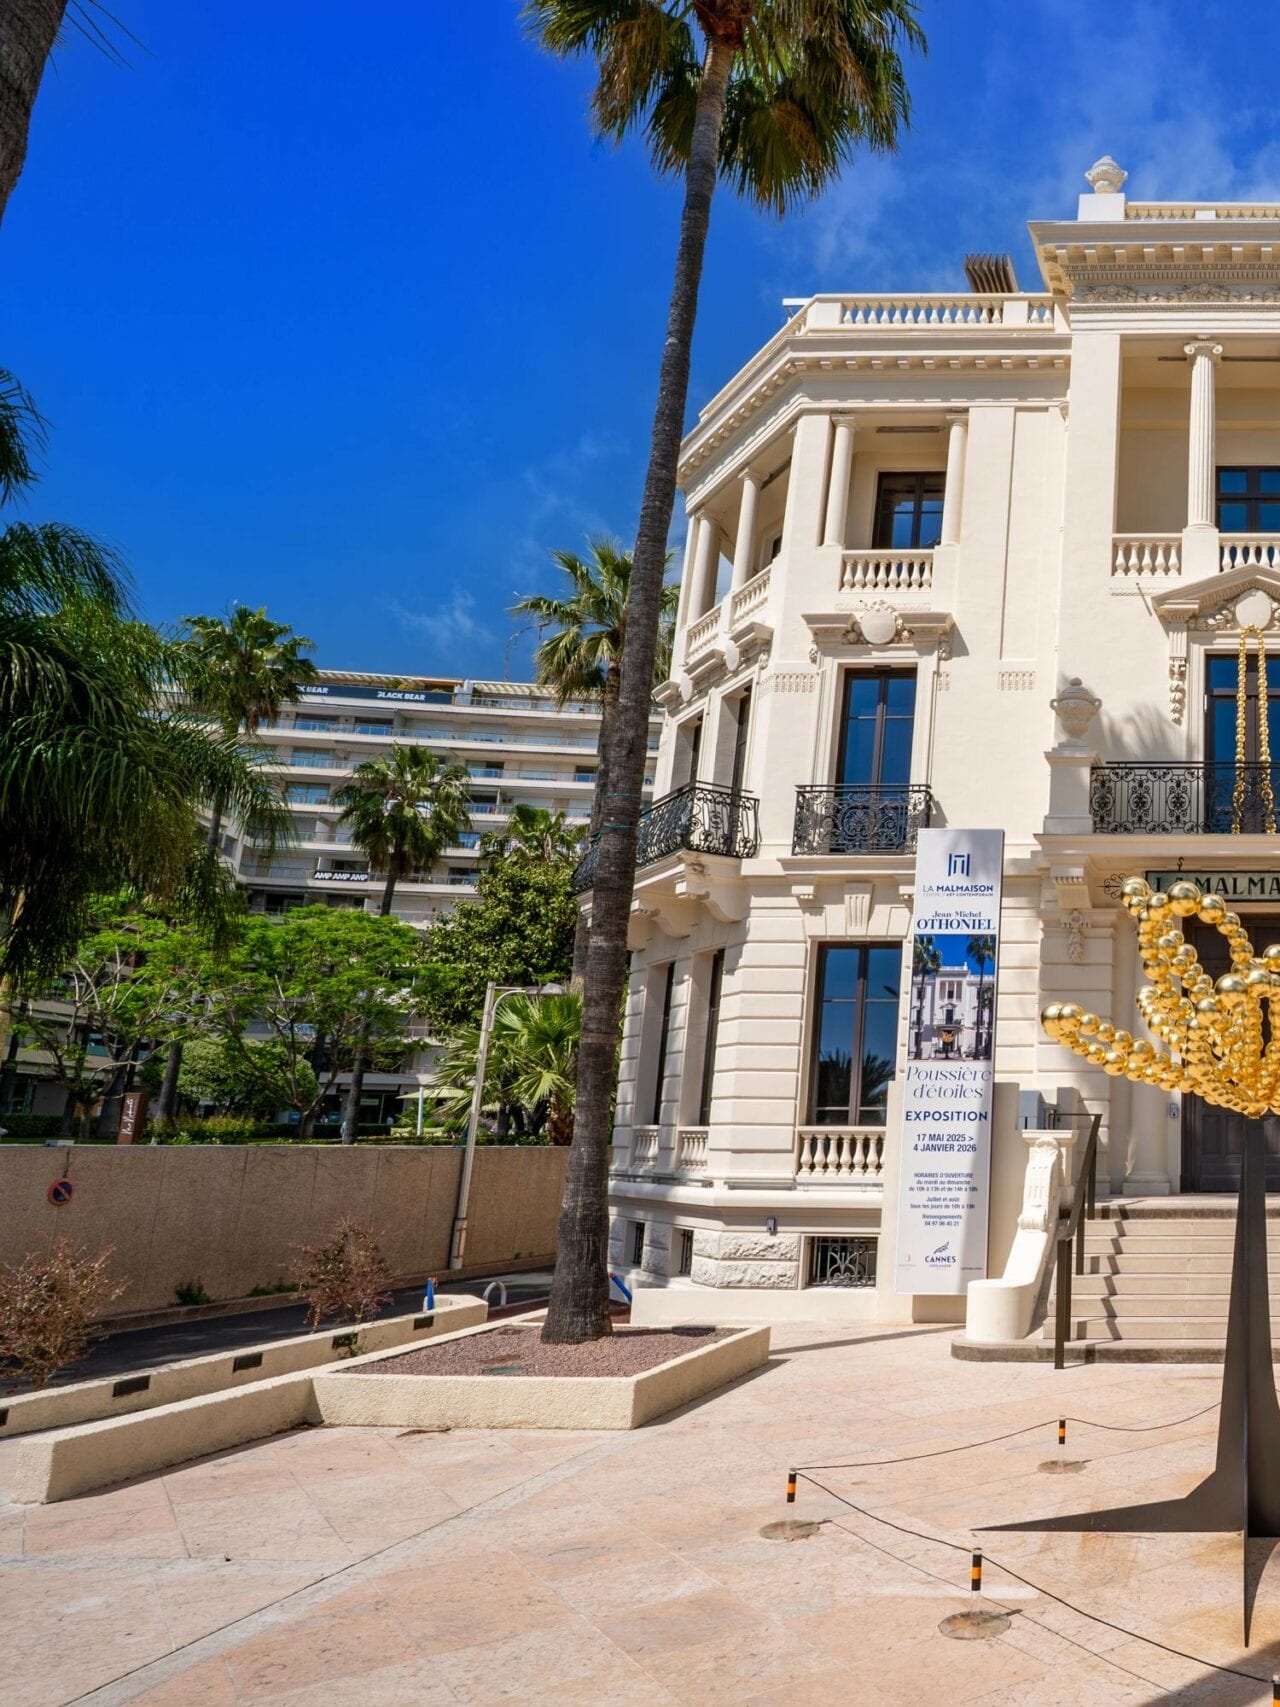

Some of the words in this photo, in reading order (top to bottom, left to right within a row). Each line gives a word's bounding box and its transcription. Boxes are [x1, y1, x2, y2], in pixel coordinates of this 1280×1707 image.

[306, 686, 329, 694] BEAR
[404, 693, 426, 701] BEAR
[314, 872, 332, 880] AMP
[350, 873, 368, 881] AMP
[922, 884, 934, 893] LA
[936, 884, 994, 893] MALMAISON
[932, 910, 952, 918] Jean
[954, 910, 982, 918] Michel
[917, 918, 996, 930] OTHONIEL
[906, 1066, 992, 1081] Poussière
[913, 1084, 984, 1099] d'étoiles
[905, 1110, 988, 1121] EXPOSITION
[916, 1133, 927, 1142] 17
[928, 1133, 944, 1142] MAI
[946, 1133, 966, 1142] 2025
[913, 1144, 918, 1152] 4
[920, 1143, 955, 1152] JANVIER
[957, 1143, 977, 1152] 2026
[924, 1255, 957, 1263] CANNES
